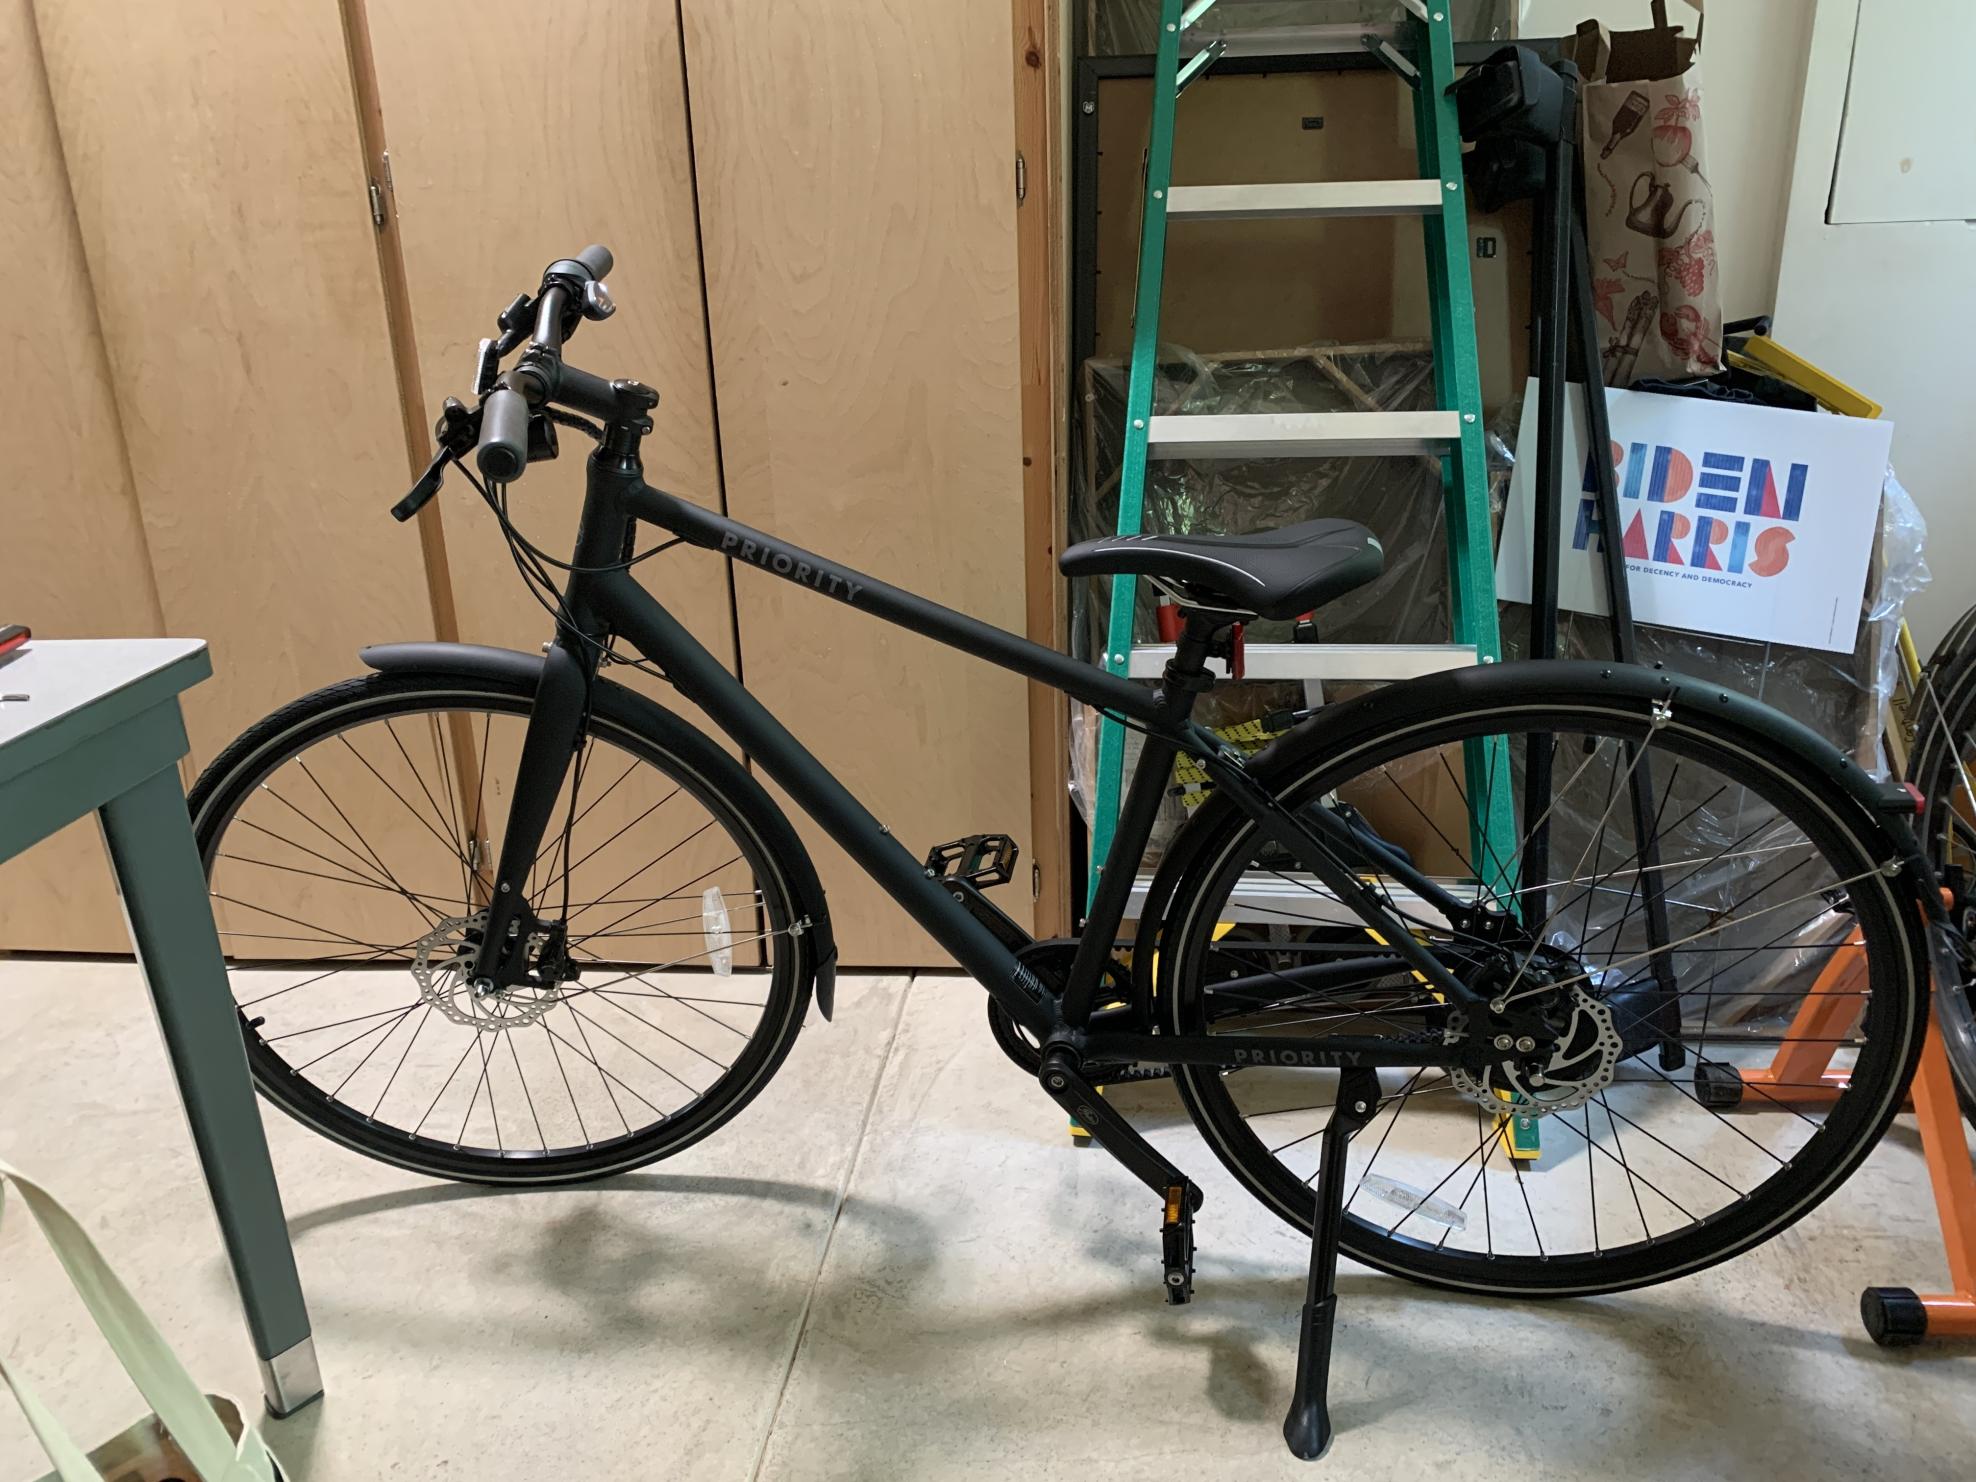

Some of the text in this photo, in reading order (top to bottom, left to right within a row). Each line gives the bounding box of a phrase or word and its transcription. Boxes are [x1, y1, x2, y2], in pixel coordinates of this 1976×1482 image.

[720, 531, 863, 601] PRIORITY
[1626, 564, 1753, 589] FOR DECENCY AND DEMOCRACY
[1235, 1049, 1361, 1066] PRIORITY
